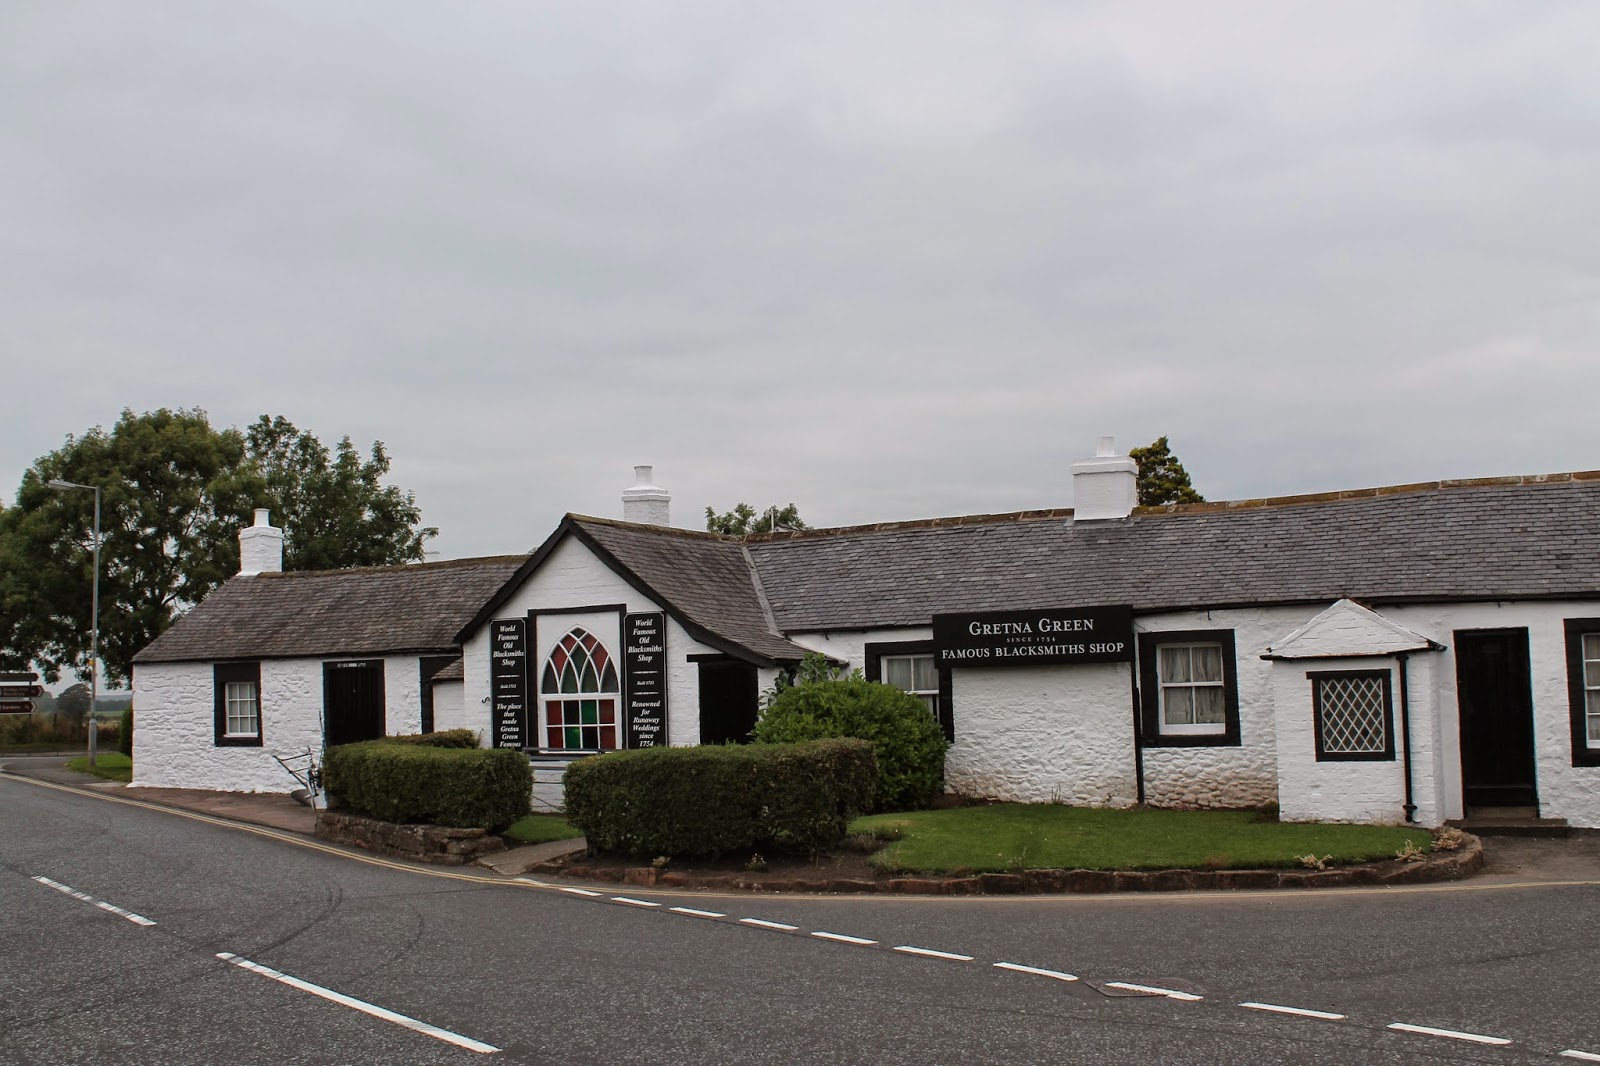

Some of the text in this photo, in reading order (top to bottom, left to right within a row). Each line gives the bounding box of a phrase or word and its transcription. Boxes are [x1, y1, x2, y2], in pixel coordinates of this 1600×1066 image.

[968, 618, 1094, 635] GRETNA GREEN
[637, 654, 653, 662] Shop
[942, 642, 1125, 659] FAMOUS BLACKSMITHS SHOP
